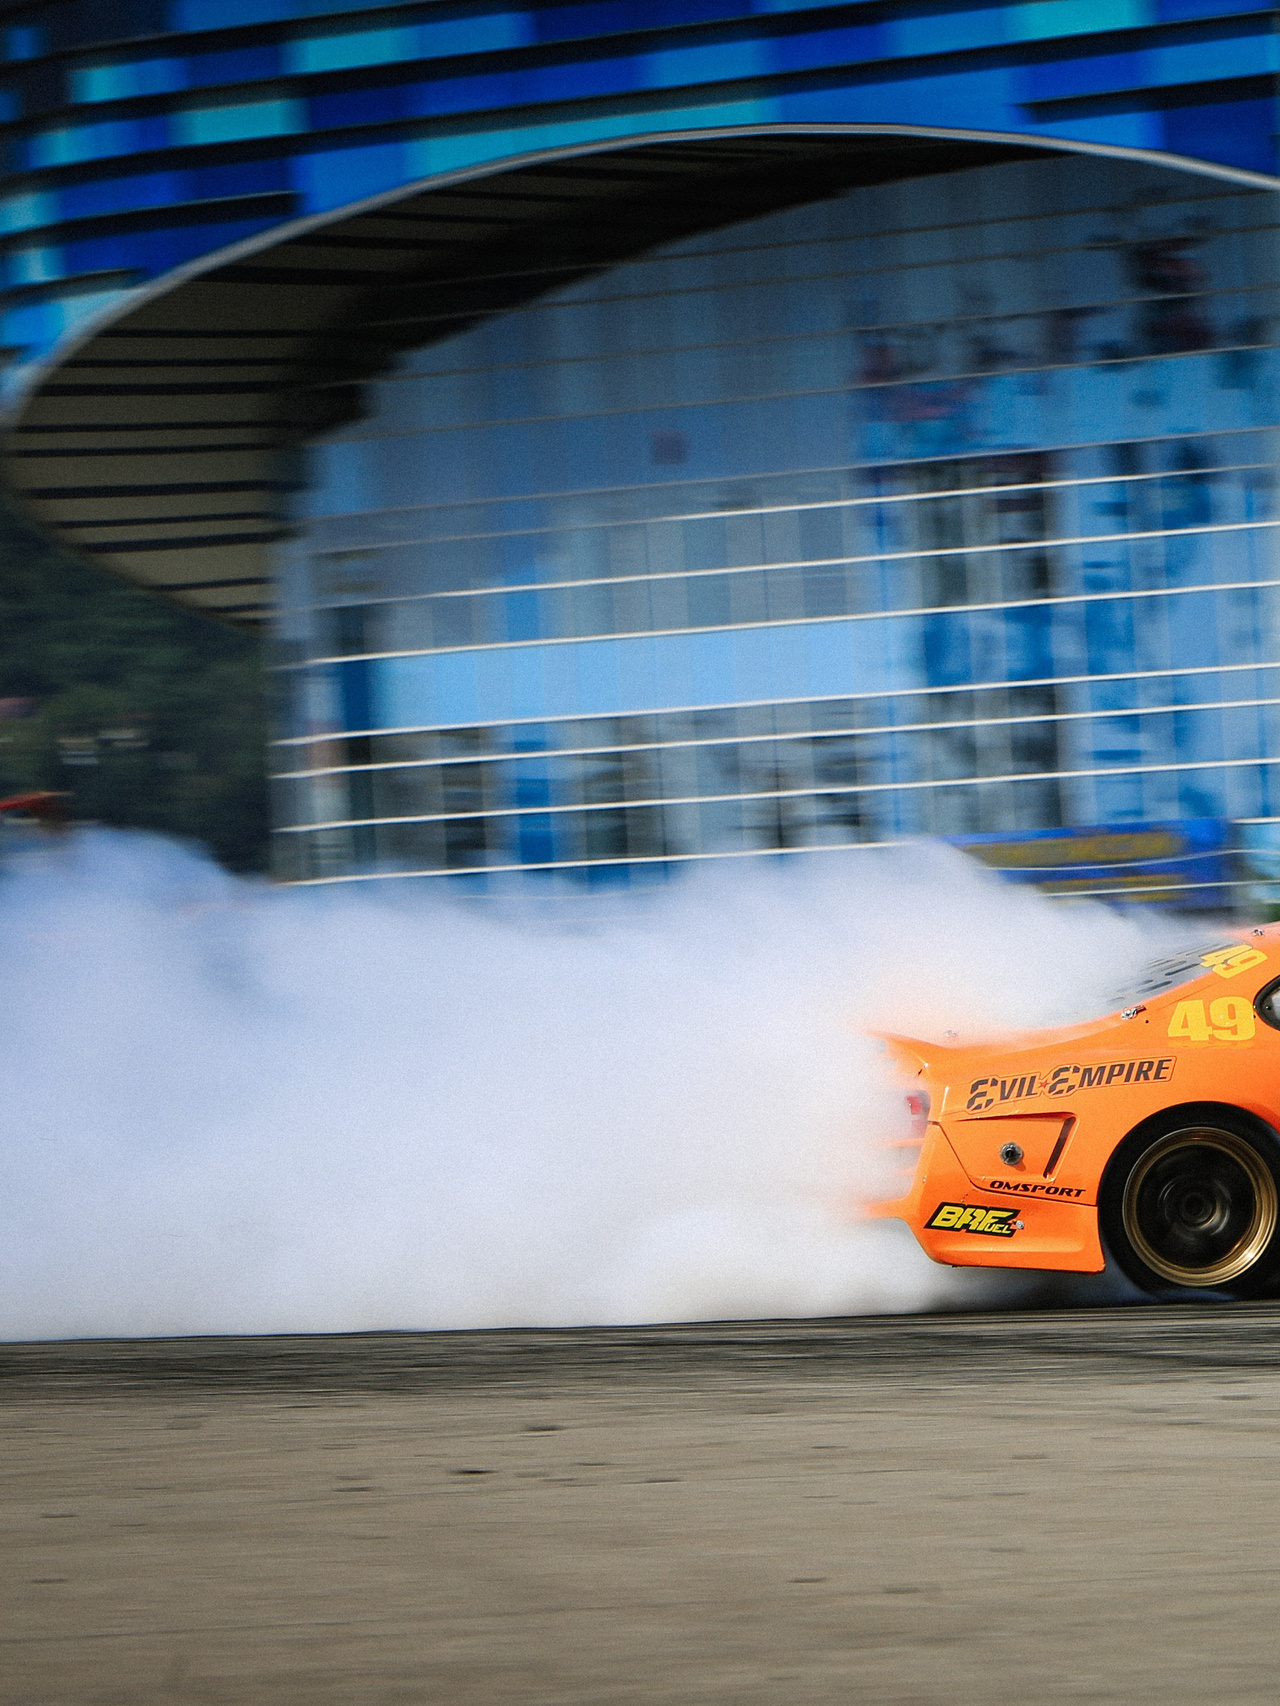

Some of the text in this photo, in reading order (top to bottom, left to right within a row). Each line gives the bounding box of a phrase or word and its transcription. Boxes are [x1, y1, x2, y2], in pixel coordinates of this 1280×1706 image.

[1200, 945, 1268, 979] 49
[1167, 996, 1256, 1042] 49
[966, 1058, 1173, 1112] EVIL EMPIRE
[989, 1180, 1086, 1198] OMSPORT
